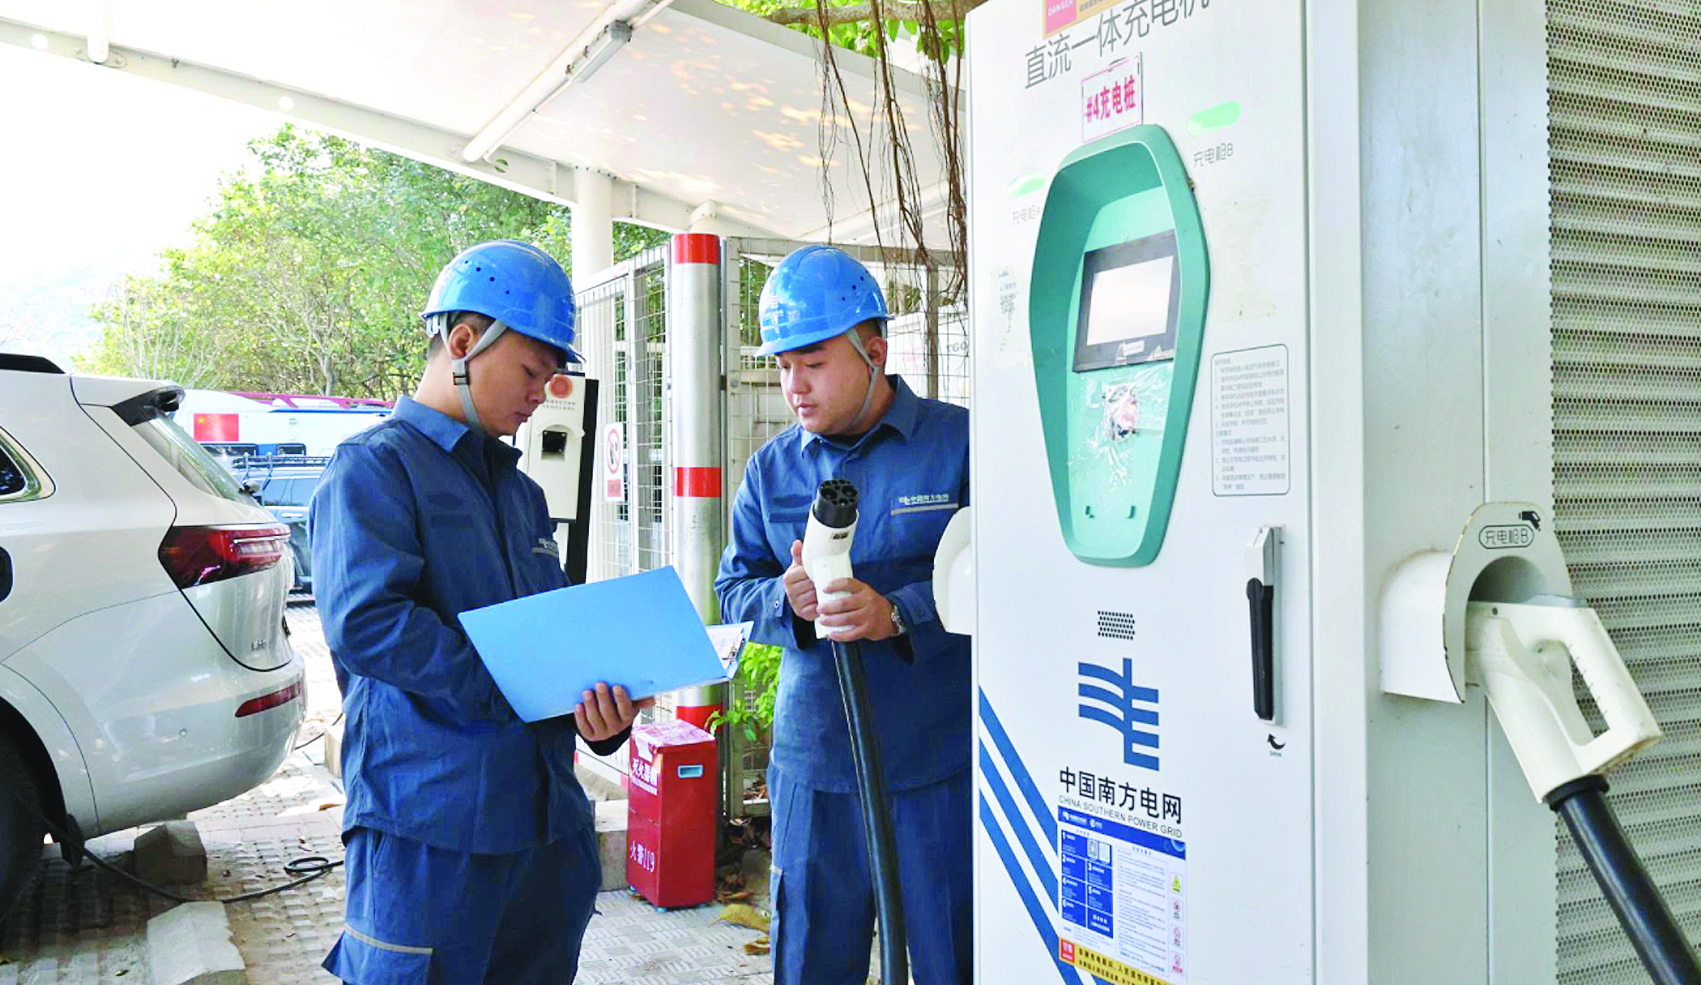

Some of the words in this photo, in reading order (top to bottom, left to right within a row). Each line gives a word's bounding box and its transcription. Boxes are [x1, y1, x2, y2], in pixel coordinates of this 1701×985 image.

[1086, 75, 1136, 123] #4充电桩
[1485, 528, 1529, 545] 充电枪B
[1058, 795, 1081, 810] CHINA
[1083, 802, 1126, 822] SOUTHERN
[1128, 815, 1158, 832] POWER
[1160, 824, 1183, 839] GRID
[1059, 766, 1181, 825] 中国南方电网
